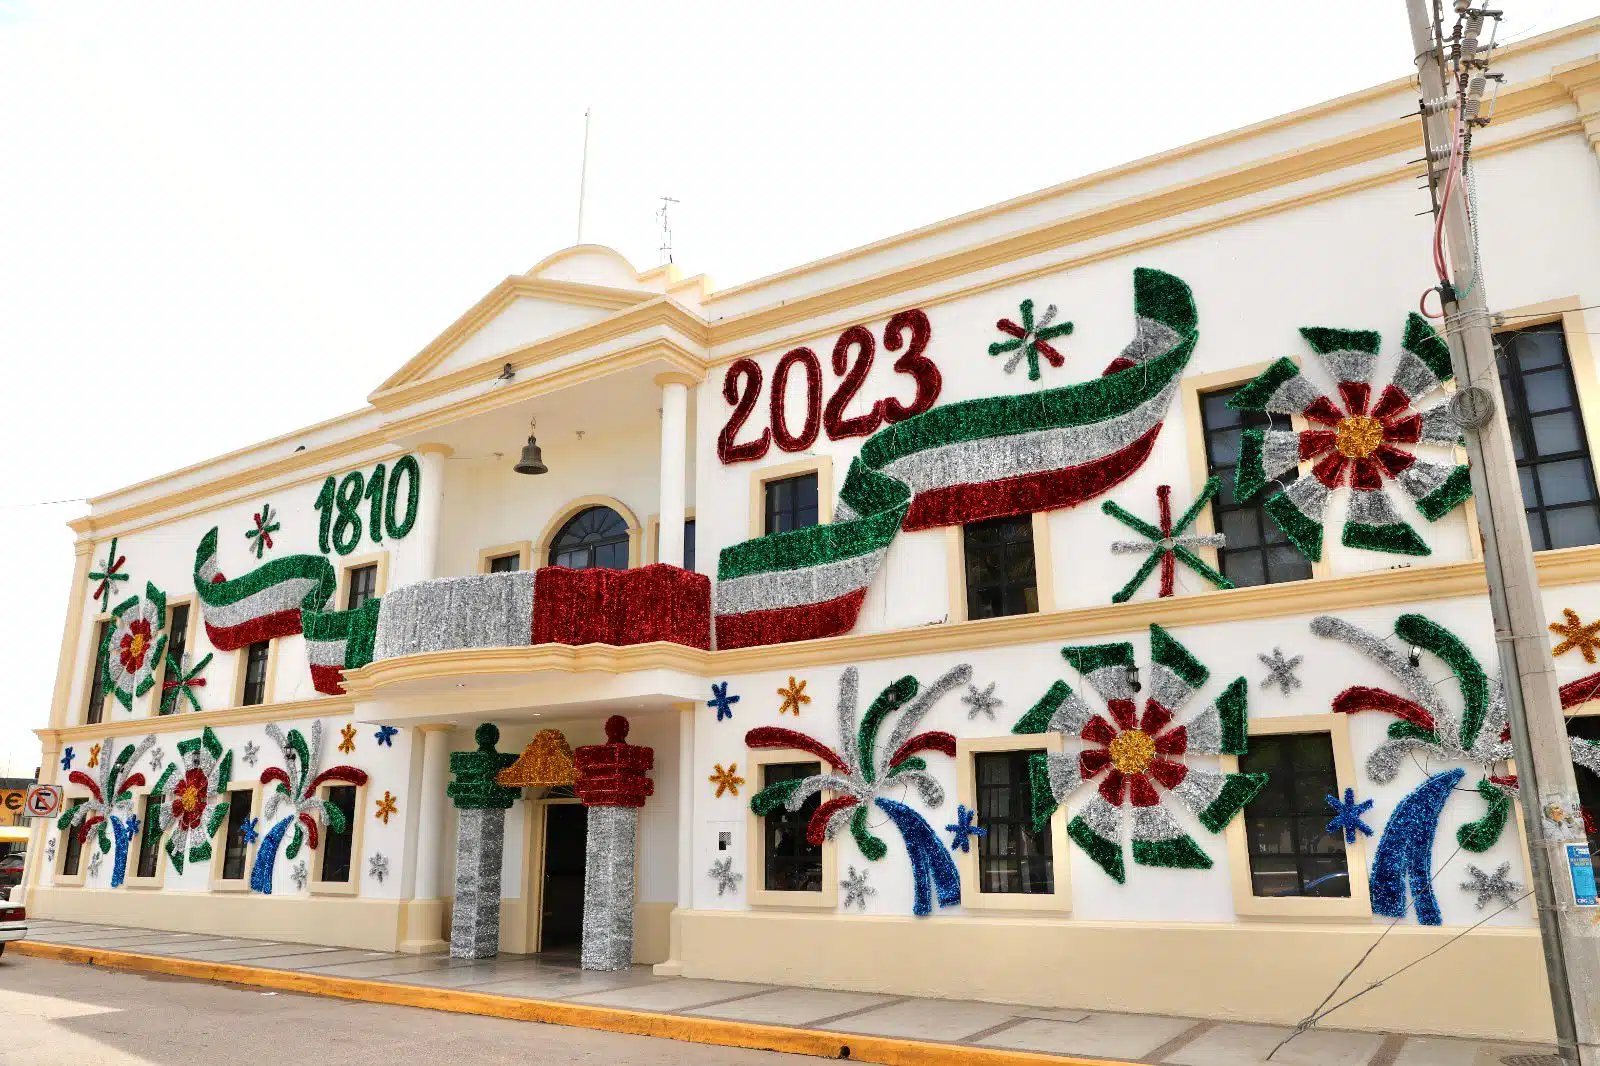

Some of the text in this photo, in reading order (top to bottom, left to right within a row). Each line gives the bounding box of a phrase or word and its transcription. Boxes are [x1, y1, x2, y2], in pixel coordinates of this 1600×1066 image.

[717, 308, 942, 465] 2023
[313, 454, 420, 556] 1810
[34, 791, 52, 810] E
